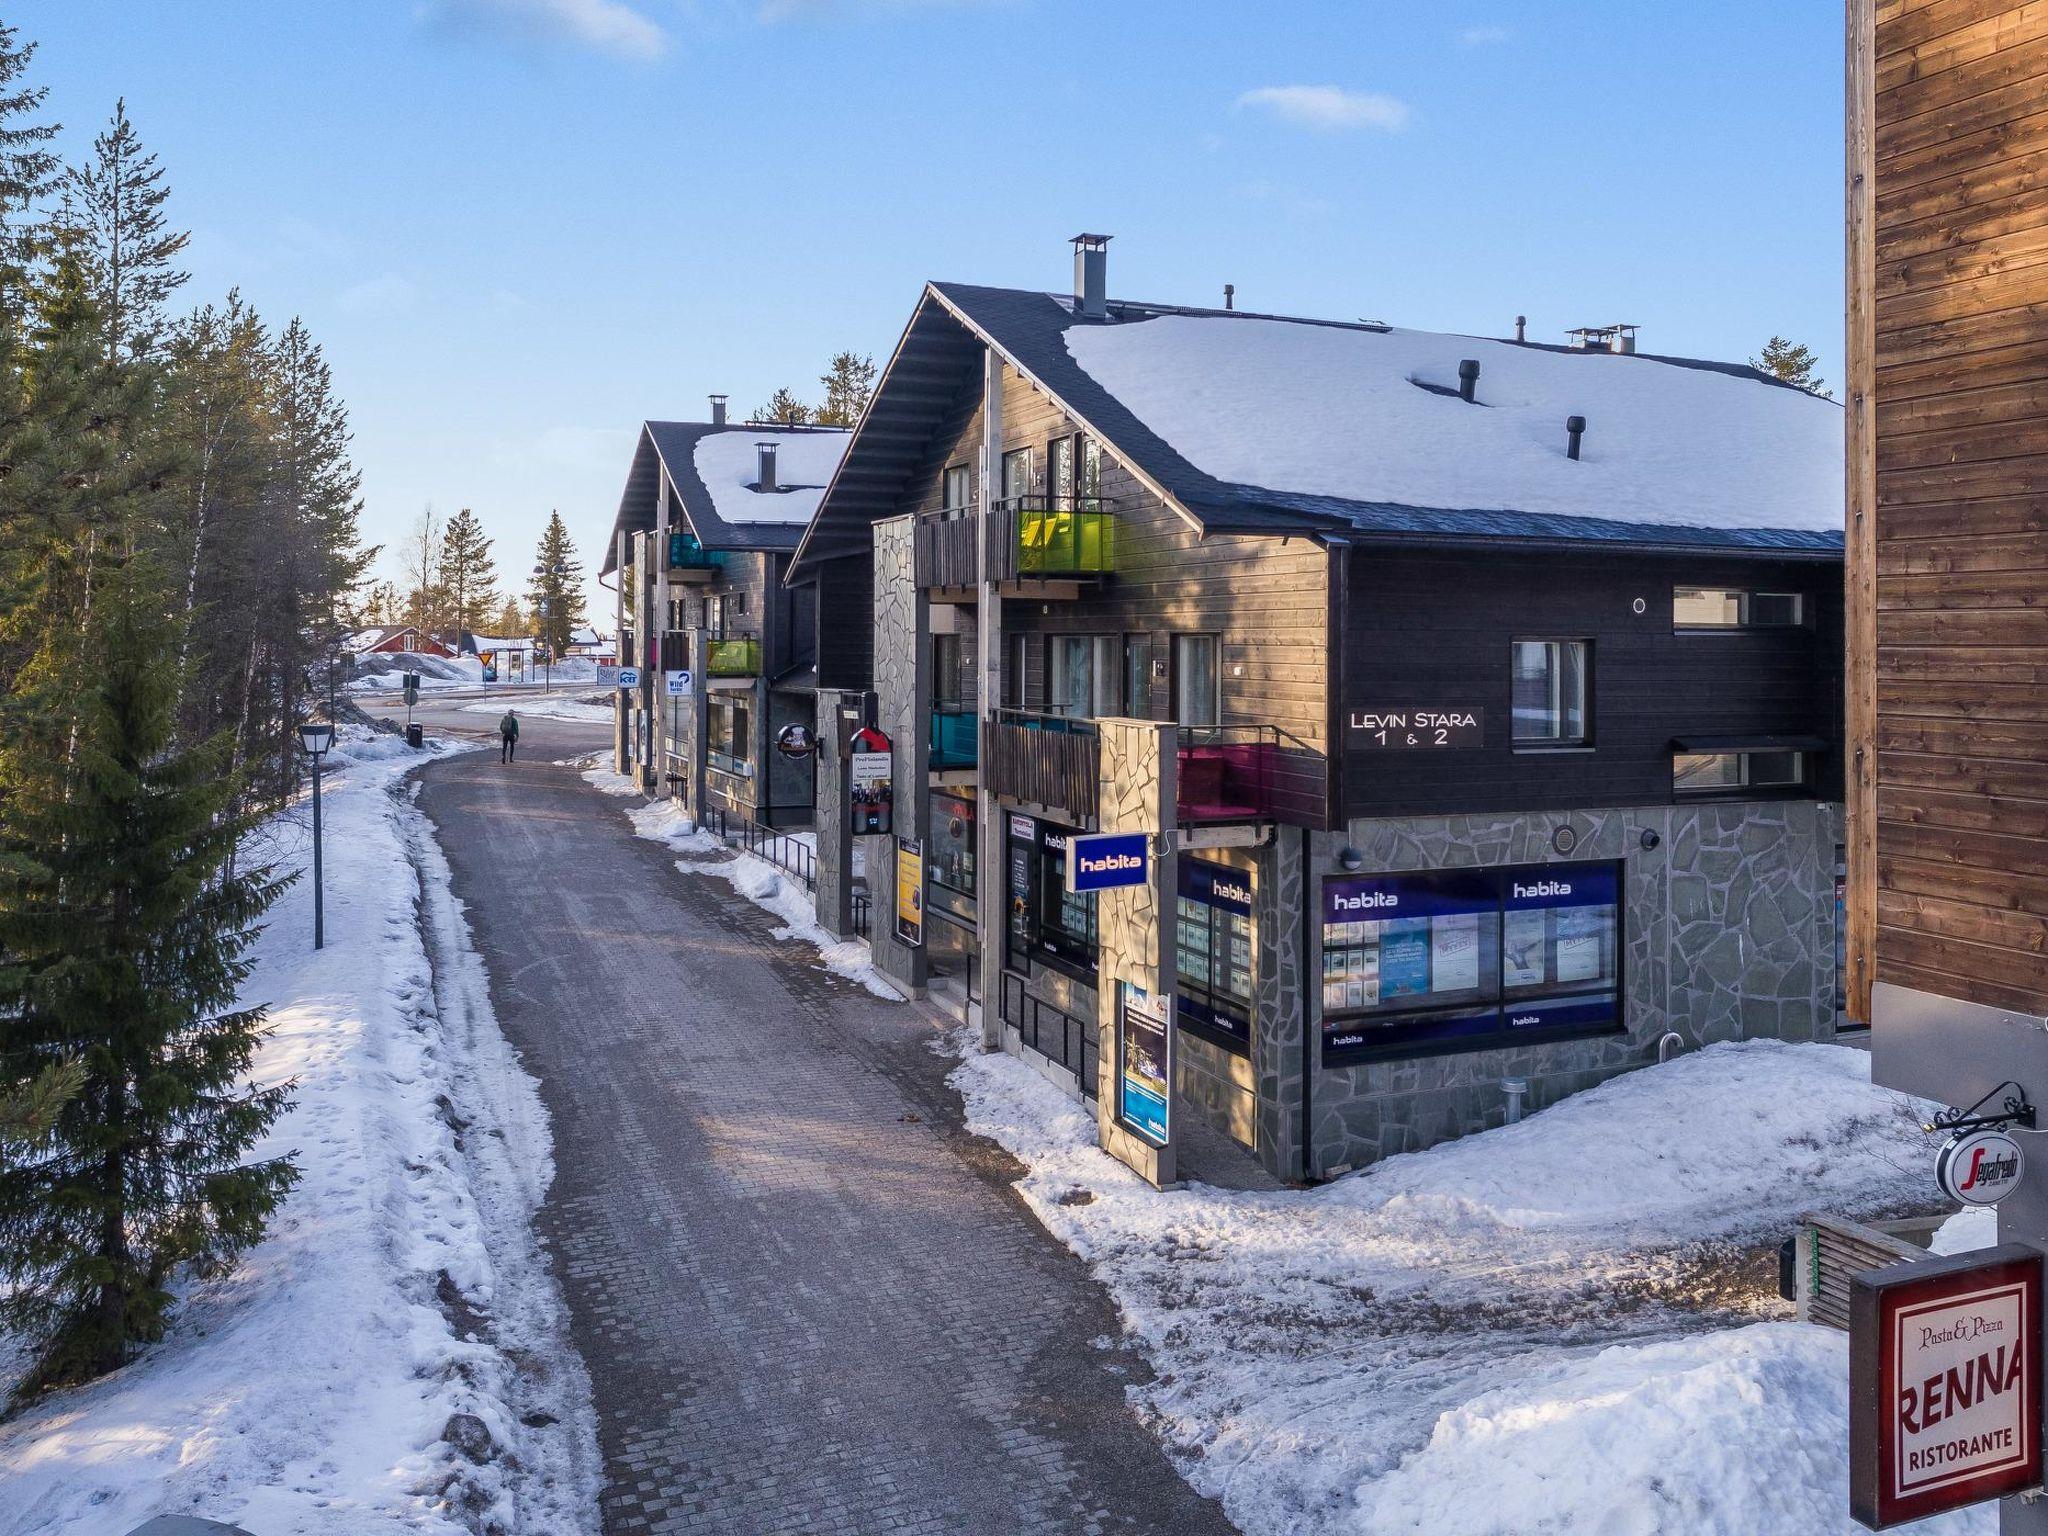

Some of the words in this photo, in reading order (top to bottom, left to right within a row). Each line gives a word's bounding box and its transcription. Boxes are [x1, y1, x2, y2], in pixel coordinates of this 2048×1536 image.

[1351, 713, 1406, 728] LEVIN
[1414, 712, 1477, 727] STARA
[1374, 730, 1387, 746] 1
[1406, 733, 1419, 745] &
[1434, 729, 1448, 745] 2
[1080, 854, 1142, 873] habita
[1213, 879, 1251, 905] habita
[1513, 881, 1572, 898] habita
[1334, 892, 1398, 910] habita
[1214, 1015, 1233, 1029] habita
[1512, 1016, 1540, 1026] habita
[1333, 1034, 1363, 1045] habita
[1919, 1327, 1952, 1350] Pasta
[1954, 1316, 1968, 1340] &
[1969, 1316, 2003, 1341] Pizza
[1902, 1338, 2022, 1435] RENNA
[1909, 1428, 2012, 1472] RISTORANTE
